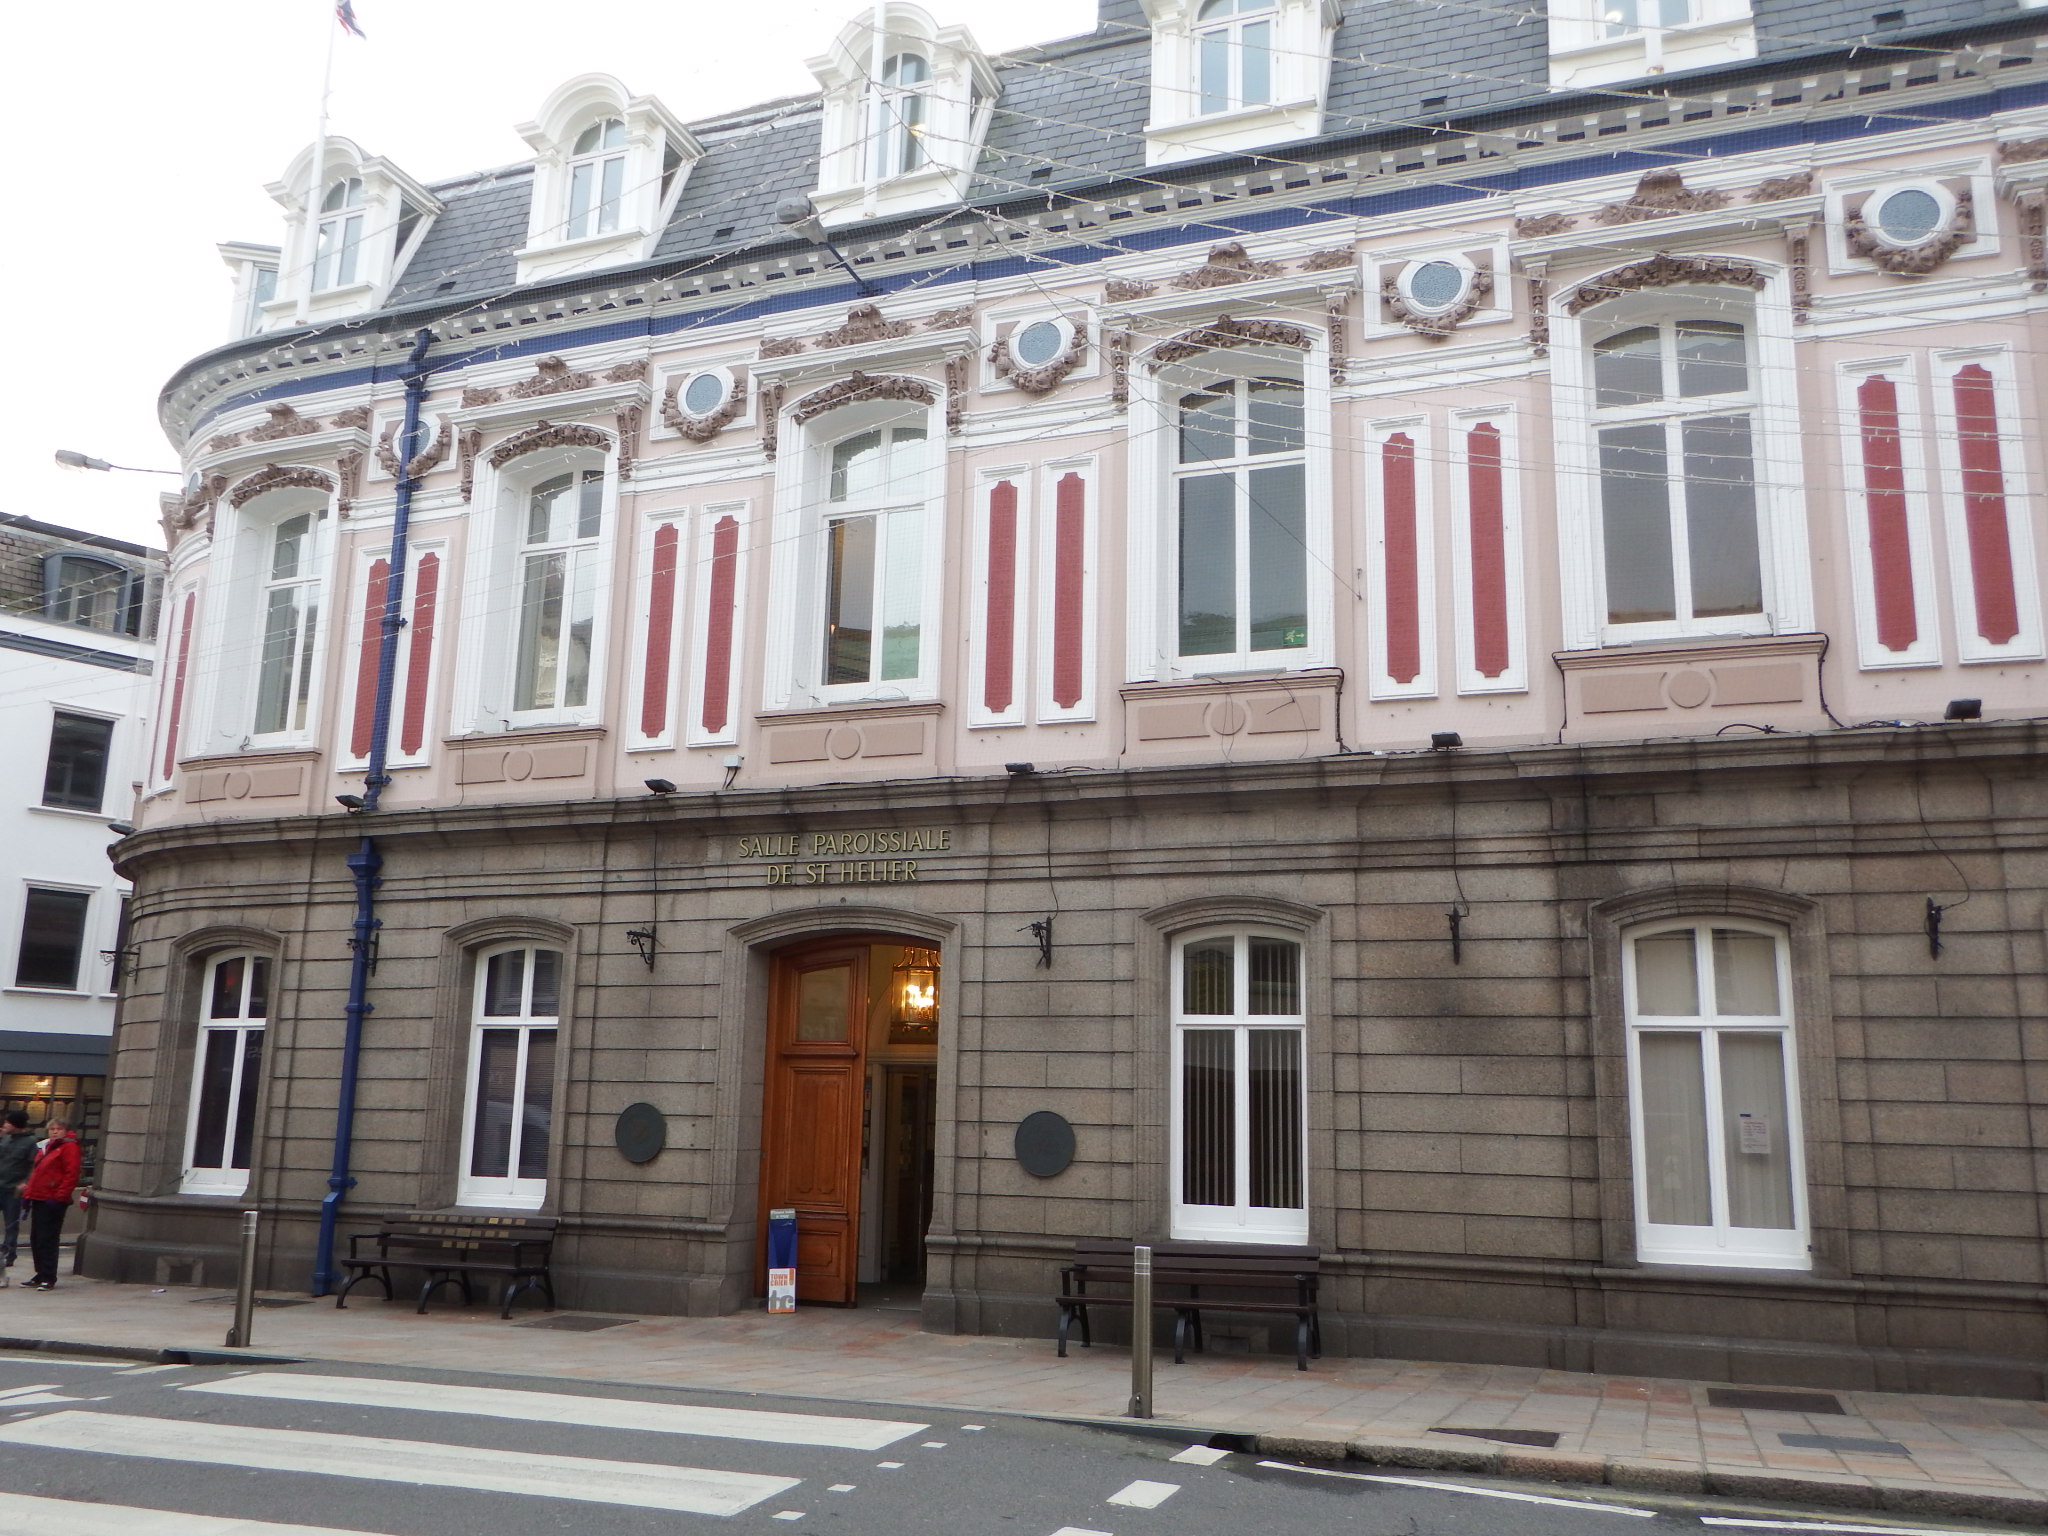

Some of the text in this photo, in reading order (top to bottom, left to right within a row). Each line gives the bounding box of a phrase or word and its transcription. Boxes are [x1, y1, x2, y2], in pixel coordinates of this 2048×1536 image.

[738, 829, 951, 857] SALLE PAROISSIALE
[767, 860, 918, 884] DE ST HELIER
